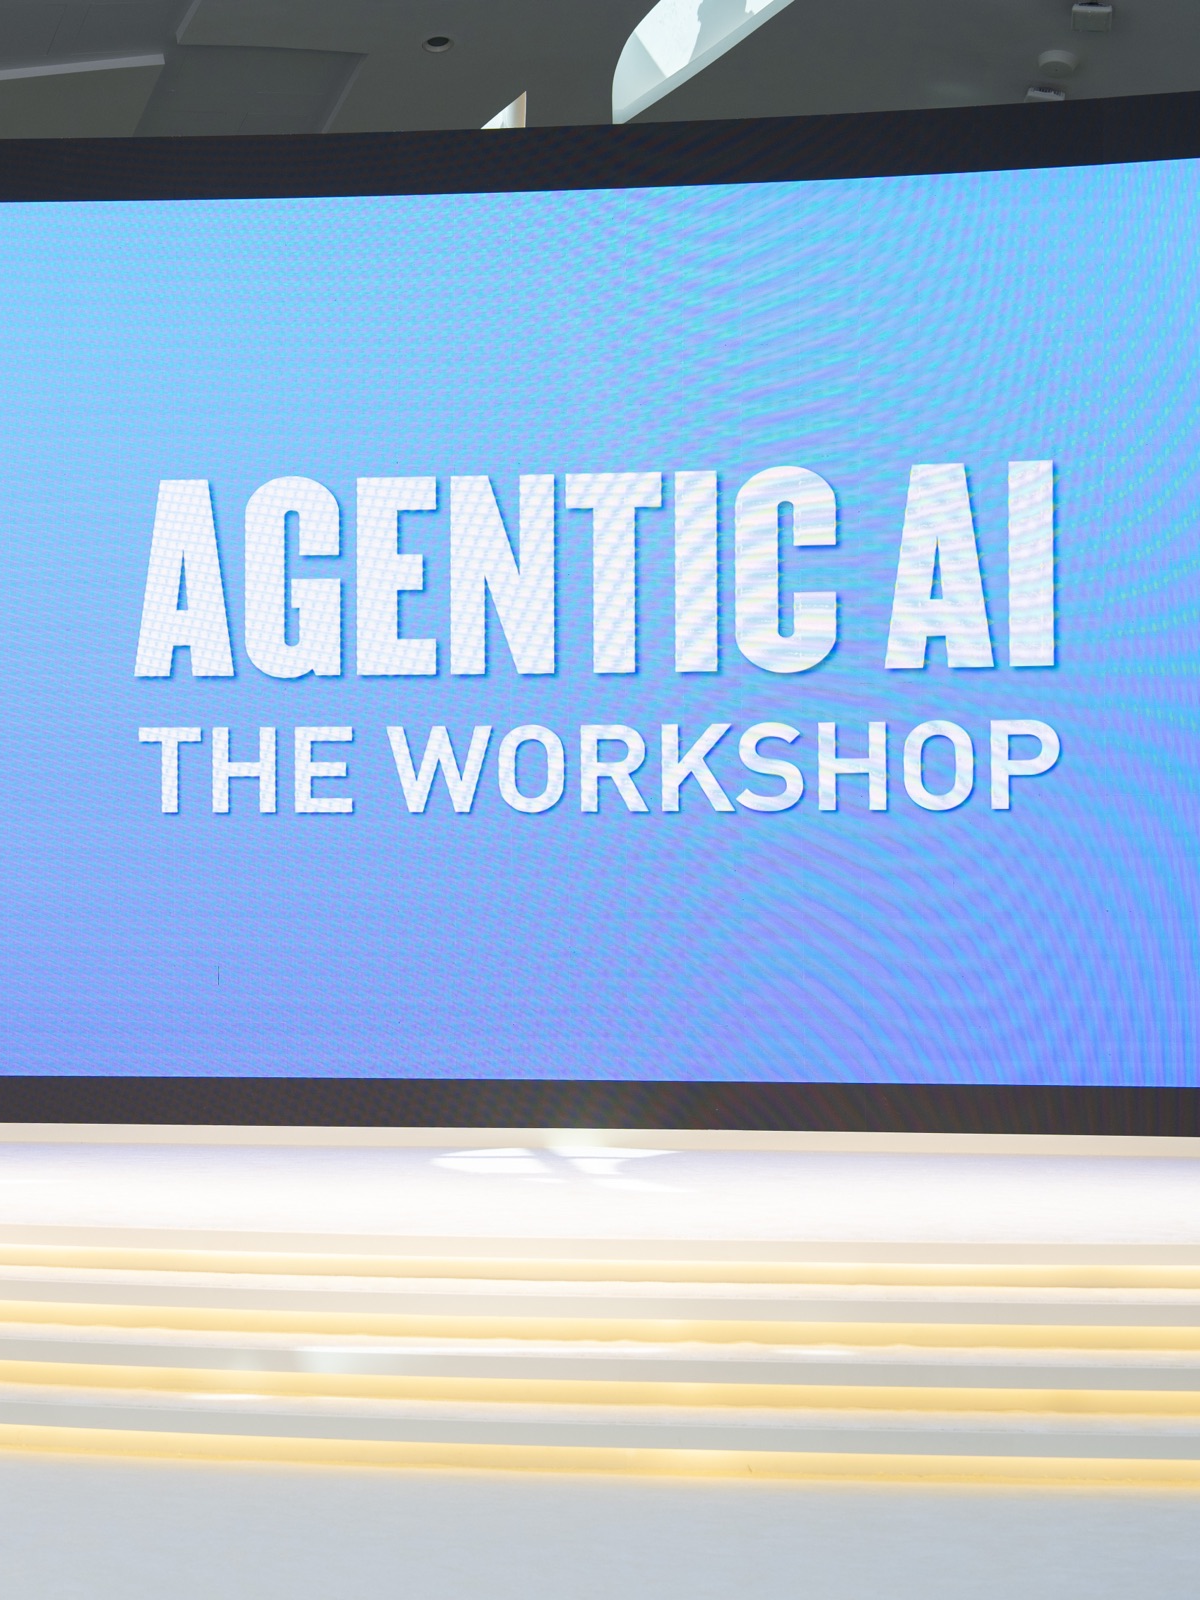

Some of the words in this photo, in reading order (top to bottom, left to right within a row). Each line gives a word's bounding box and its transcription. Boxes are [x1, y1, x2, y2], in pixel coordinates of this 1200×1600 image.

[134, 465, 838, 679] AGENTIC
[884, 460, 1055, 670] AI
[138, 726, 354, 814] THE
[386, 719, 1061, 814] WORKSHOP
